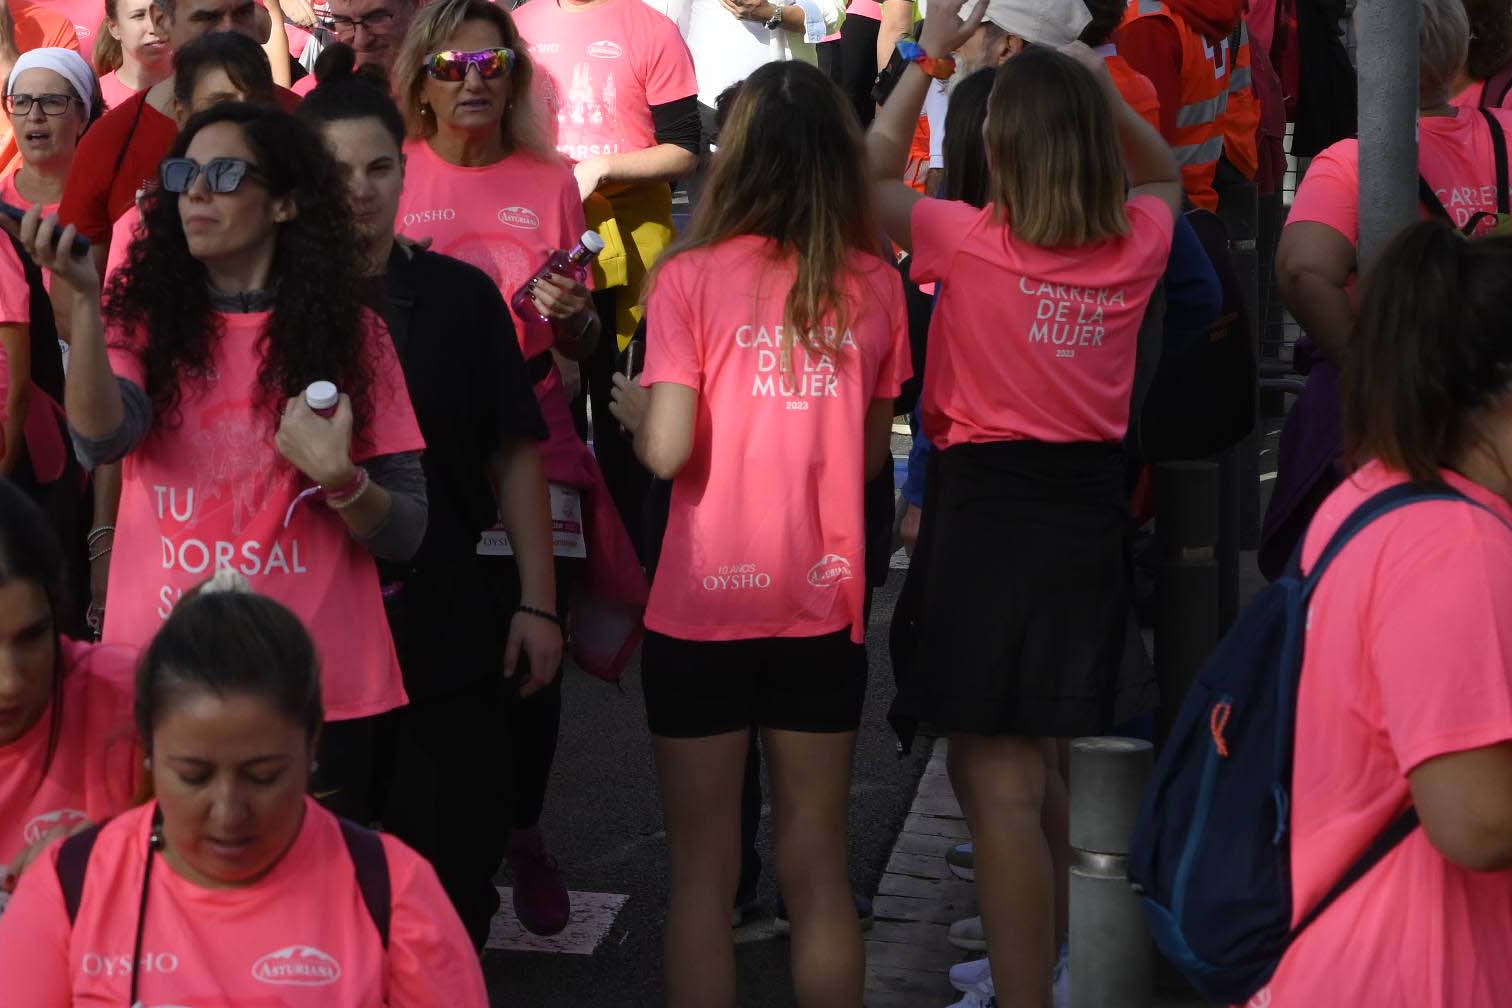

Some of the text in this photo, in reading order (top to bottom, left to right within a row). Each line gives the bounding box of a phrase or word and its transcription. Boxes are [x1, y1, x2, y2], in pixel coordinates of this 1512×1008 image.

[404, 208, 456, 226] OYSHO
[503, 212, 537, 226] ASTURIANA
[1020, 276, 1126, 307] CARRERA
[1037, 298, 1104, 324] DE LA
[1029, 320, 1105, 346] MUJER
[804, 350, 834, 372] LA
[752, 374, 838, 397] MUJER
[786, 401, 809, 410] 2023
[153, 485, 194, 522] TU
[161, 535, 308, 575] DORSAL
[703, 572, 770, 591] OYSHO
[261, 962, 334, 978] ASTURIANA
